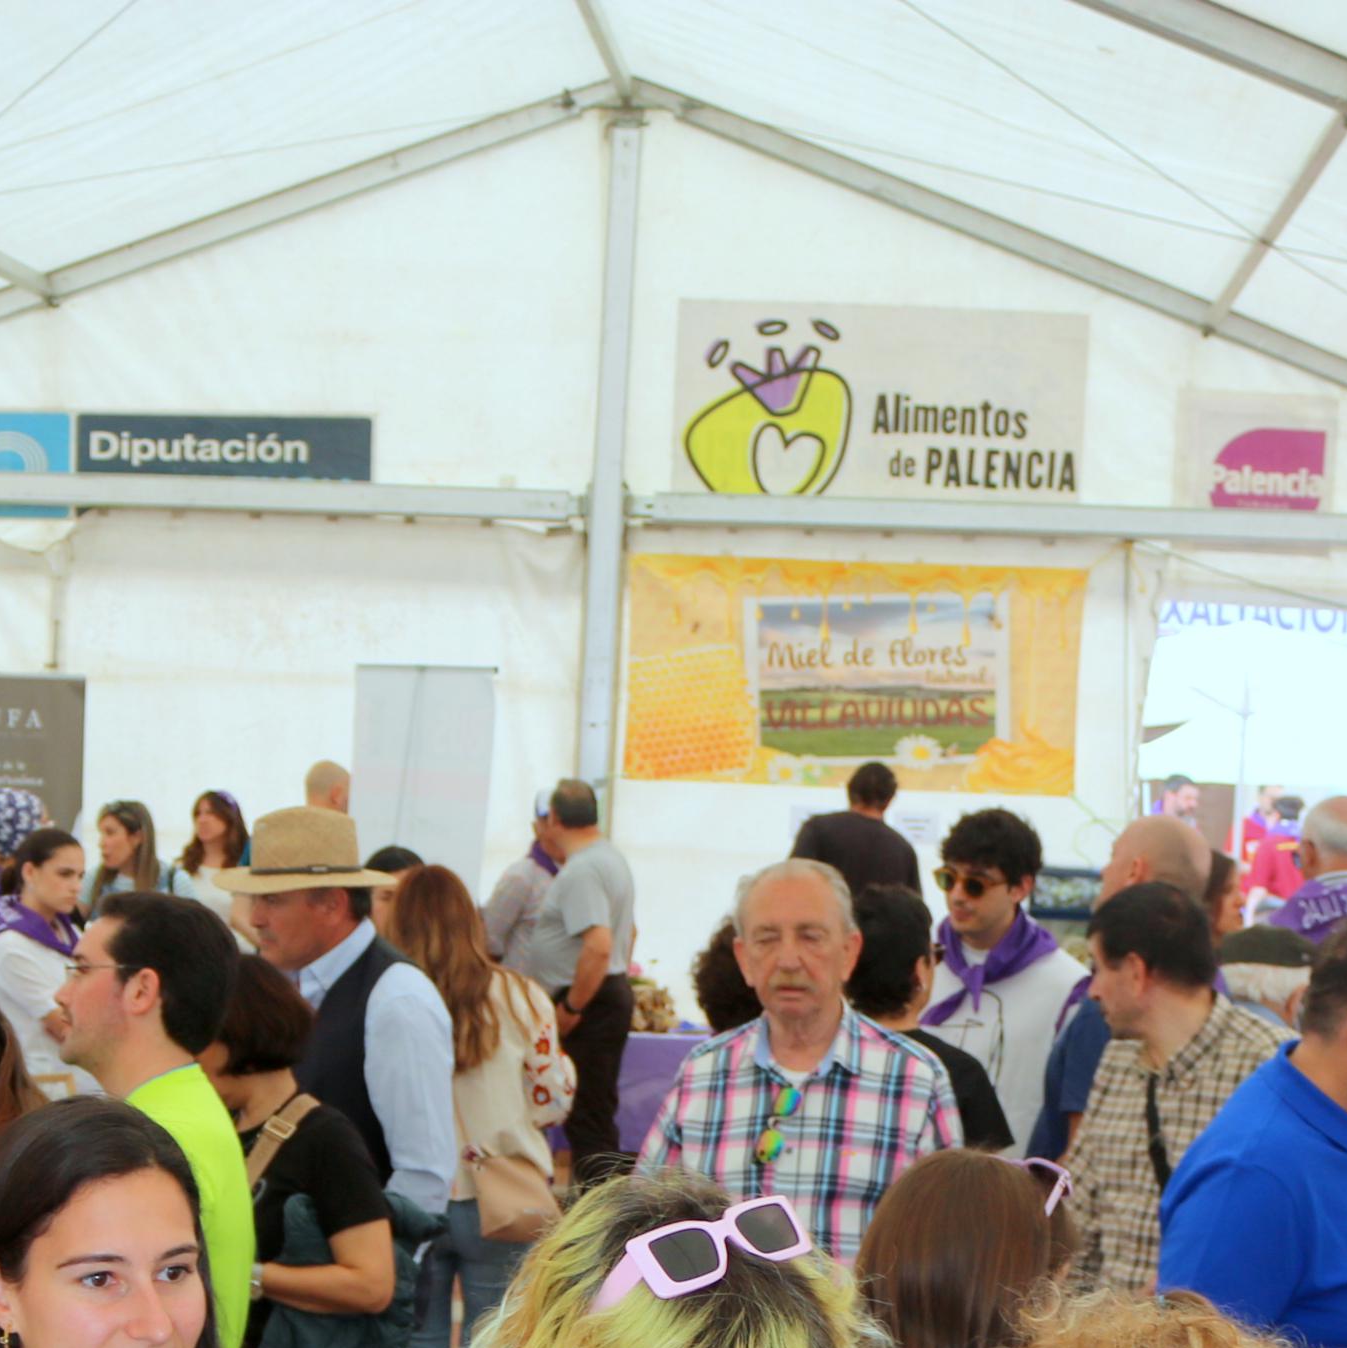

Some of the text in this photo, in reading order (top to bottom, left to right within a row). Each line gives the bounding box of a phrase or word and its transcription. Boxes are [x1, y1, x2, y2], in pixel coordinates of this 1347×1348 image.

[872, 394, 1028, 440] Alimentos
[89, 431, 308, 466] Diputación
[889, 447, 1076, 492] de PALENCIA
[1209, 463, 1325, 498] Palencia
[768, 637, 967, 669] Miel de flores
